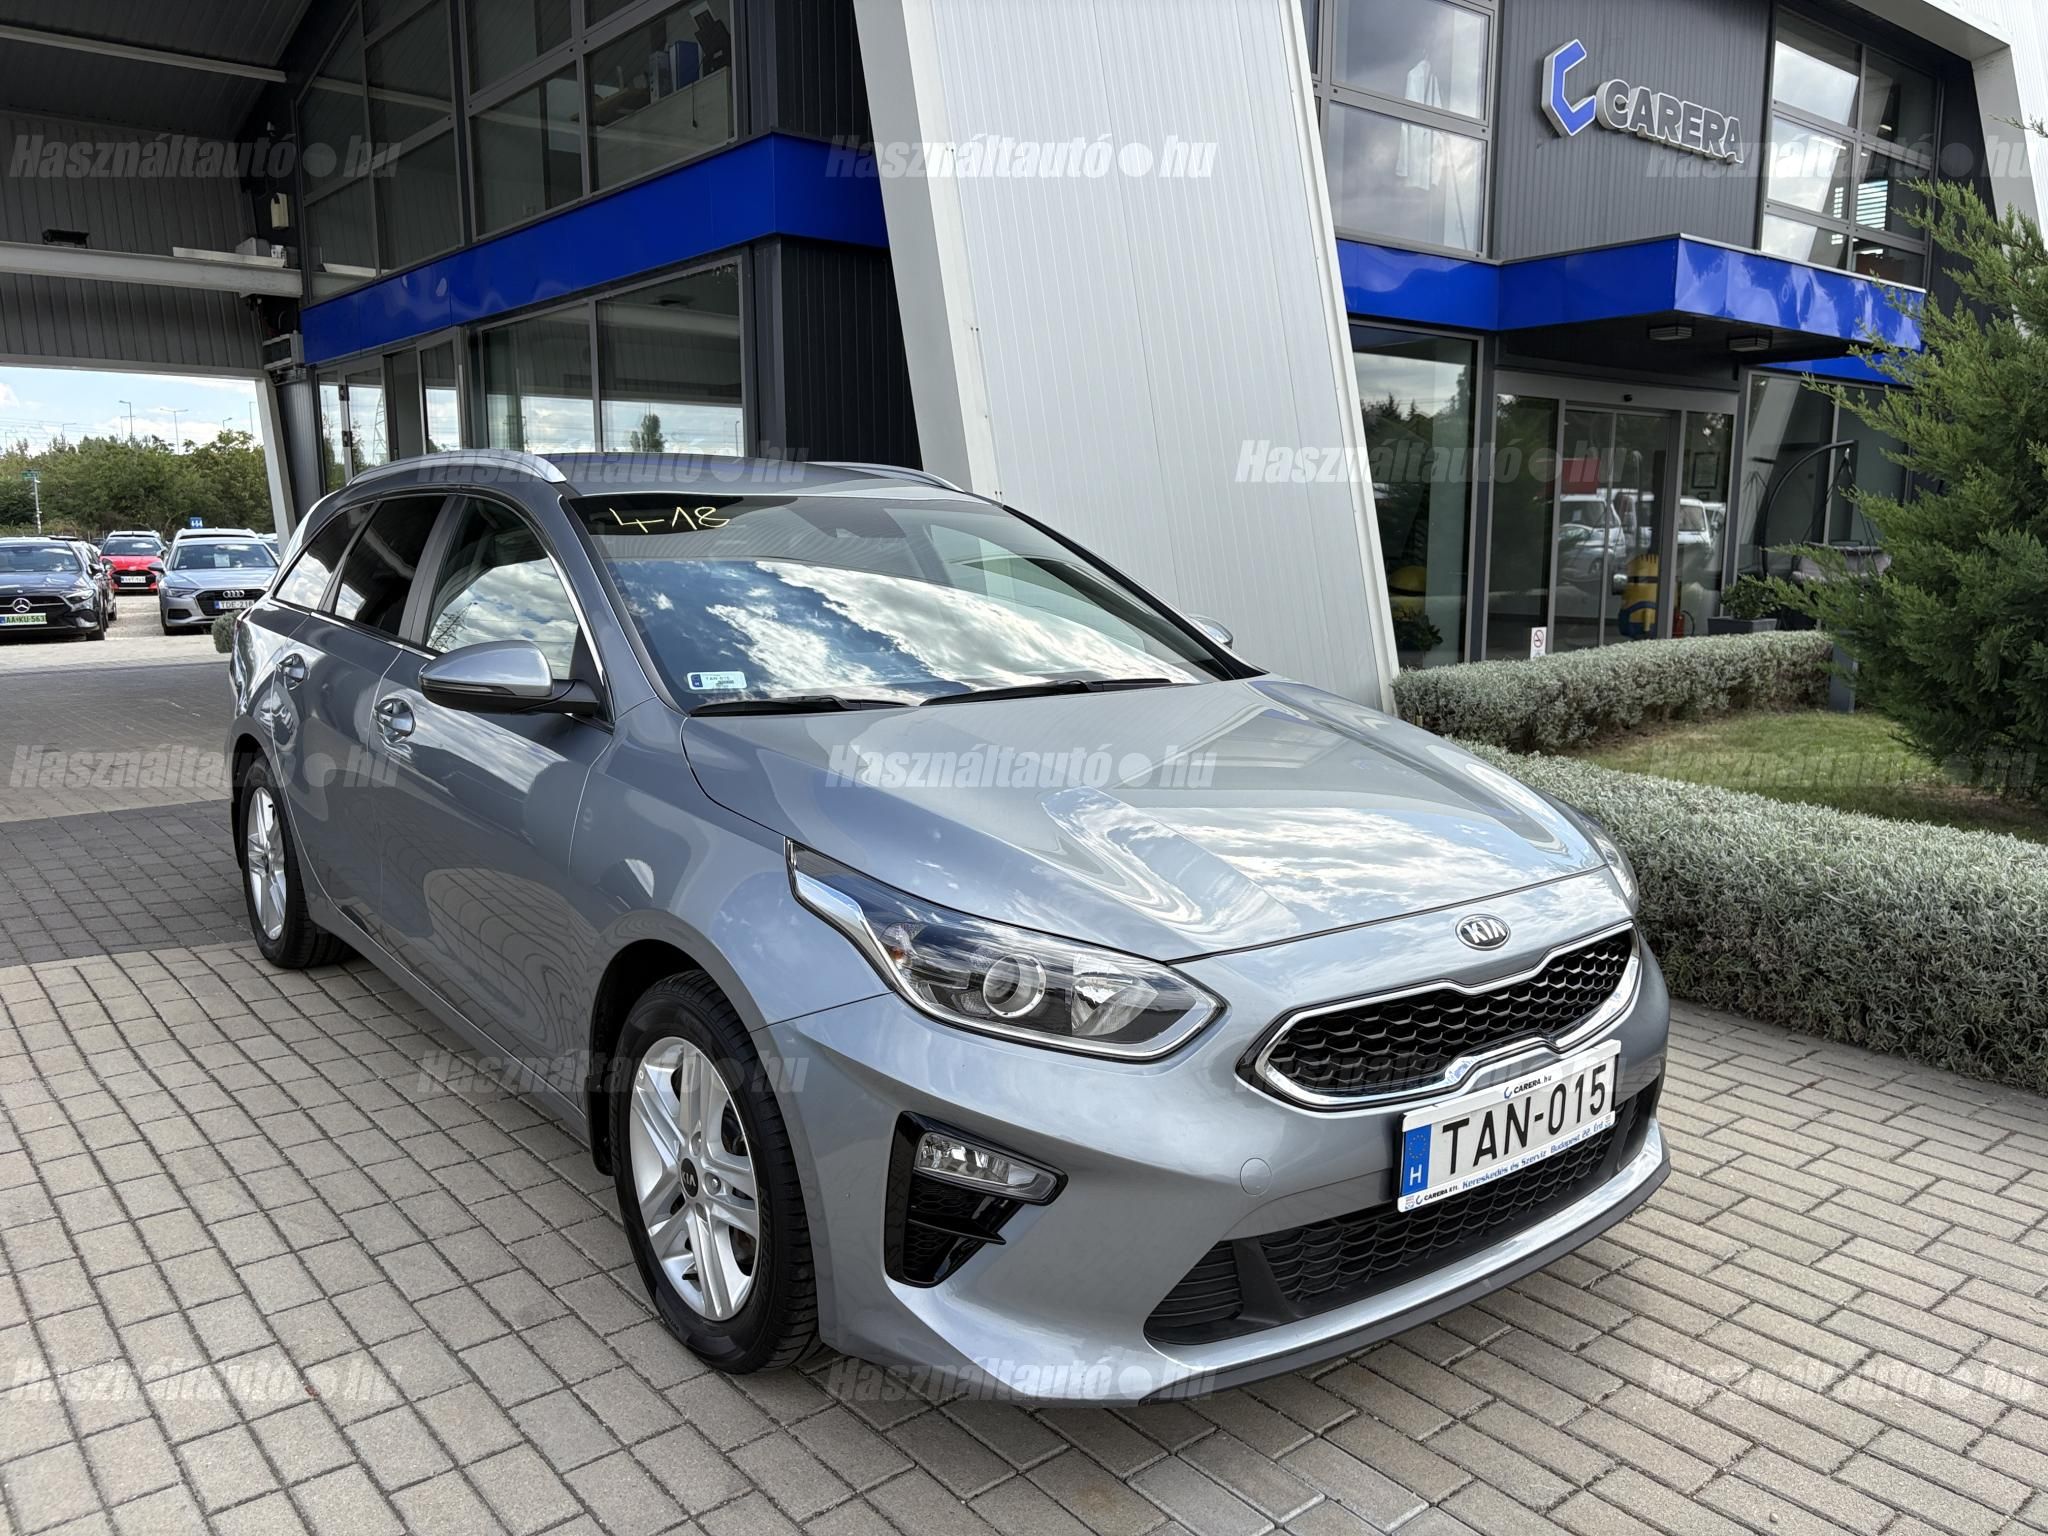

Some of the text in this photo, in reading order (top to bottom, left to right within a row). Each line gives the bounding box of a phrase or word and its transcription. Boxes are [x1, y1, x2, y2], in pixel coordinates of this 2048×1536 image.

[1596, 78, 1744, 163] CARERA
[1464, 919, 1506, 943] KIA
[1442, 1063, 1607, 1176] TAN-015
[682, 1171, 697, 1187] KIA
[1409, 1164, 1422, 1187] H
[1424, 1188, 1448, 1201] CARERA
[1462, 1165, 1508, 1189] Kereskedés
[1521, 1150, 1547, 1167] Szerviz
[1550, 1134, 1581, 1154] Budapest
